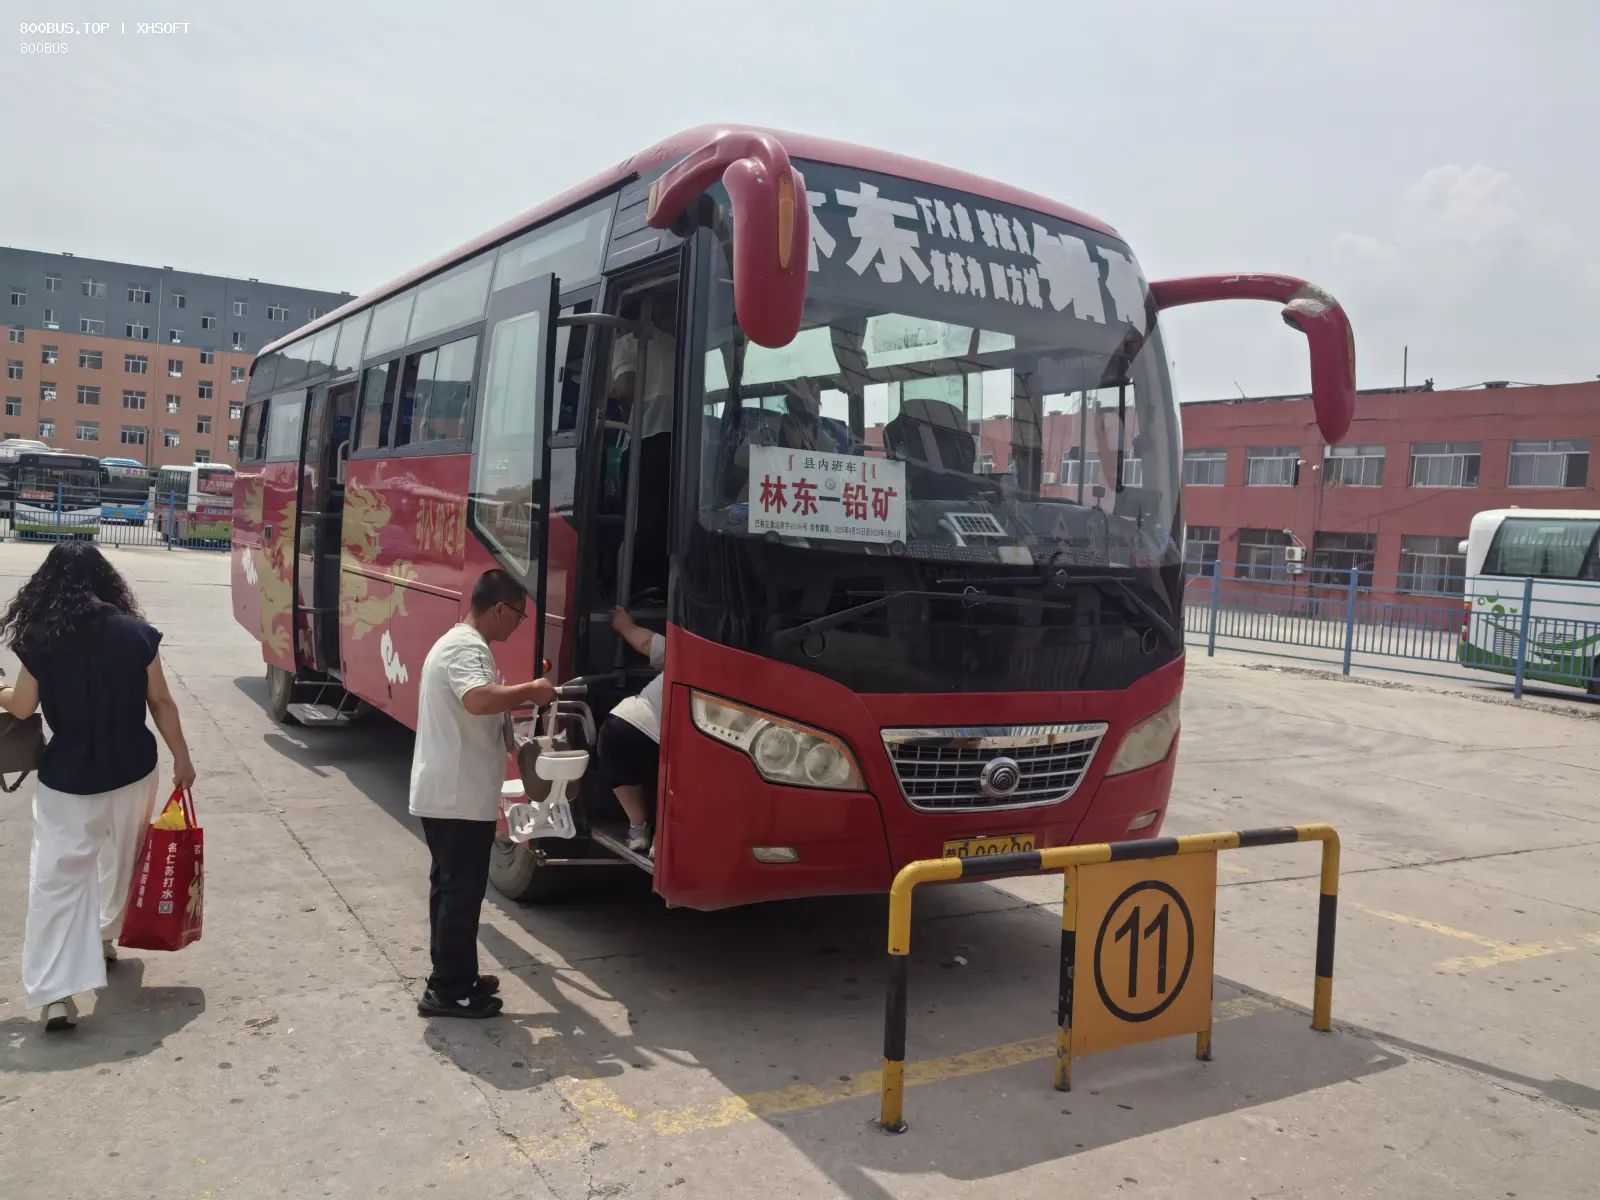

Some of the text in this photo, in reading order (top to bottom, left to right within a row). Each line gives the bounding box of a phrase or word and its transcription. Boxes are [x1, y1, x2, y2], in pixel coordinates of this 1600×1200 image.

[803, 456, 857, 474] 县内班车
[161, 842, 178, 899] 名仁苏打水
[1114, 903, 1169, 998] 11
